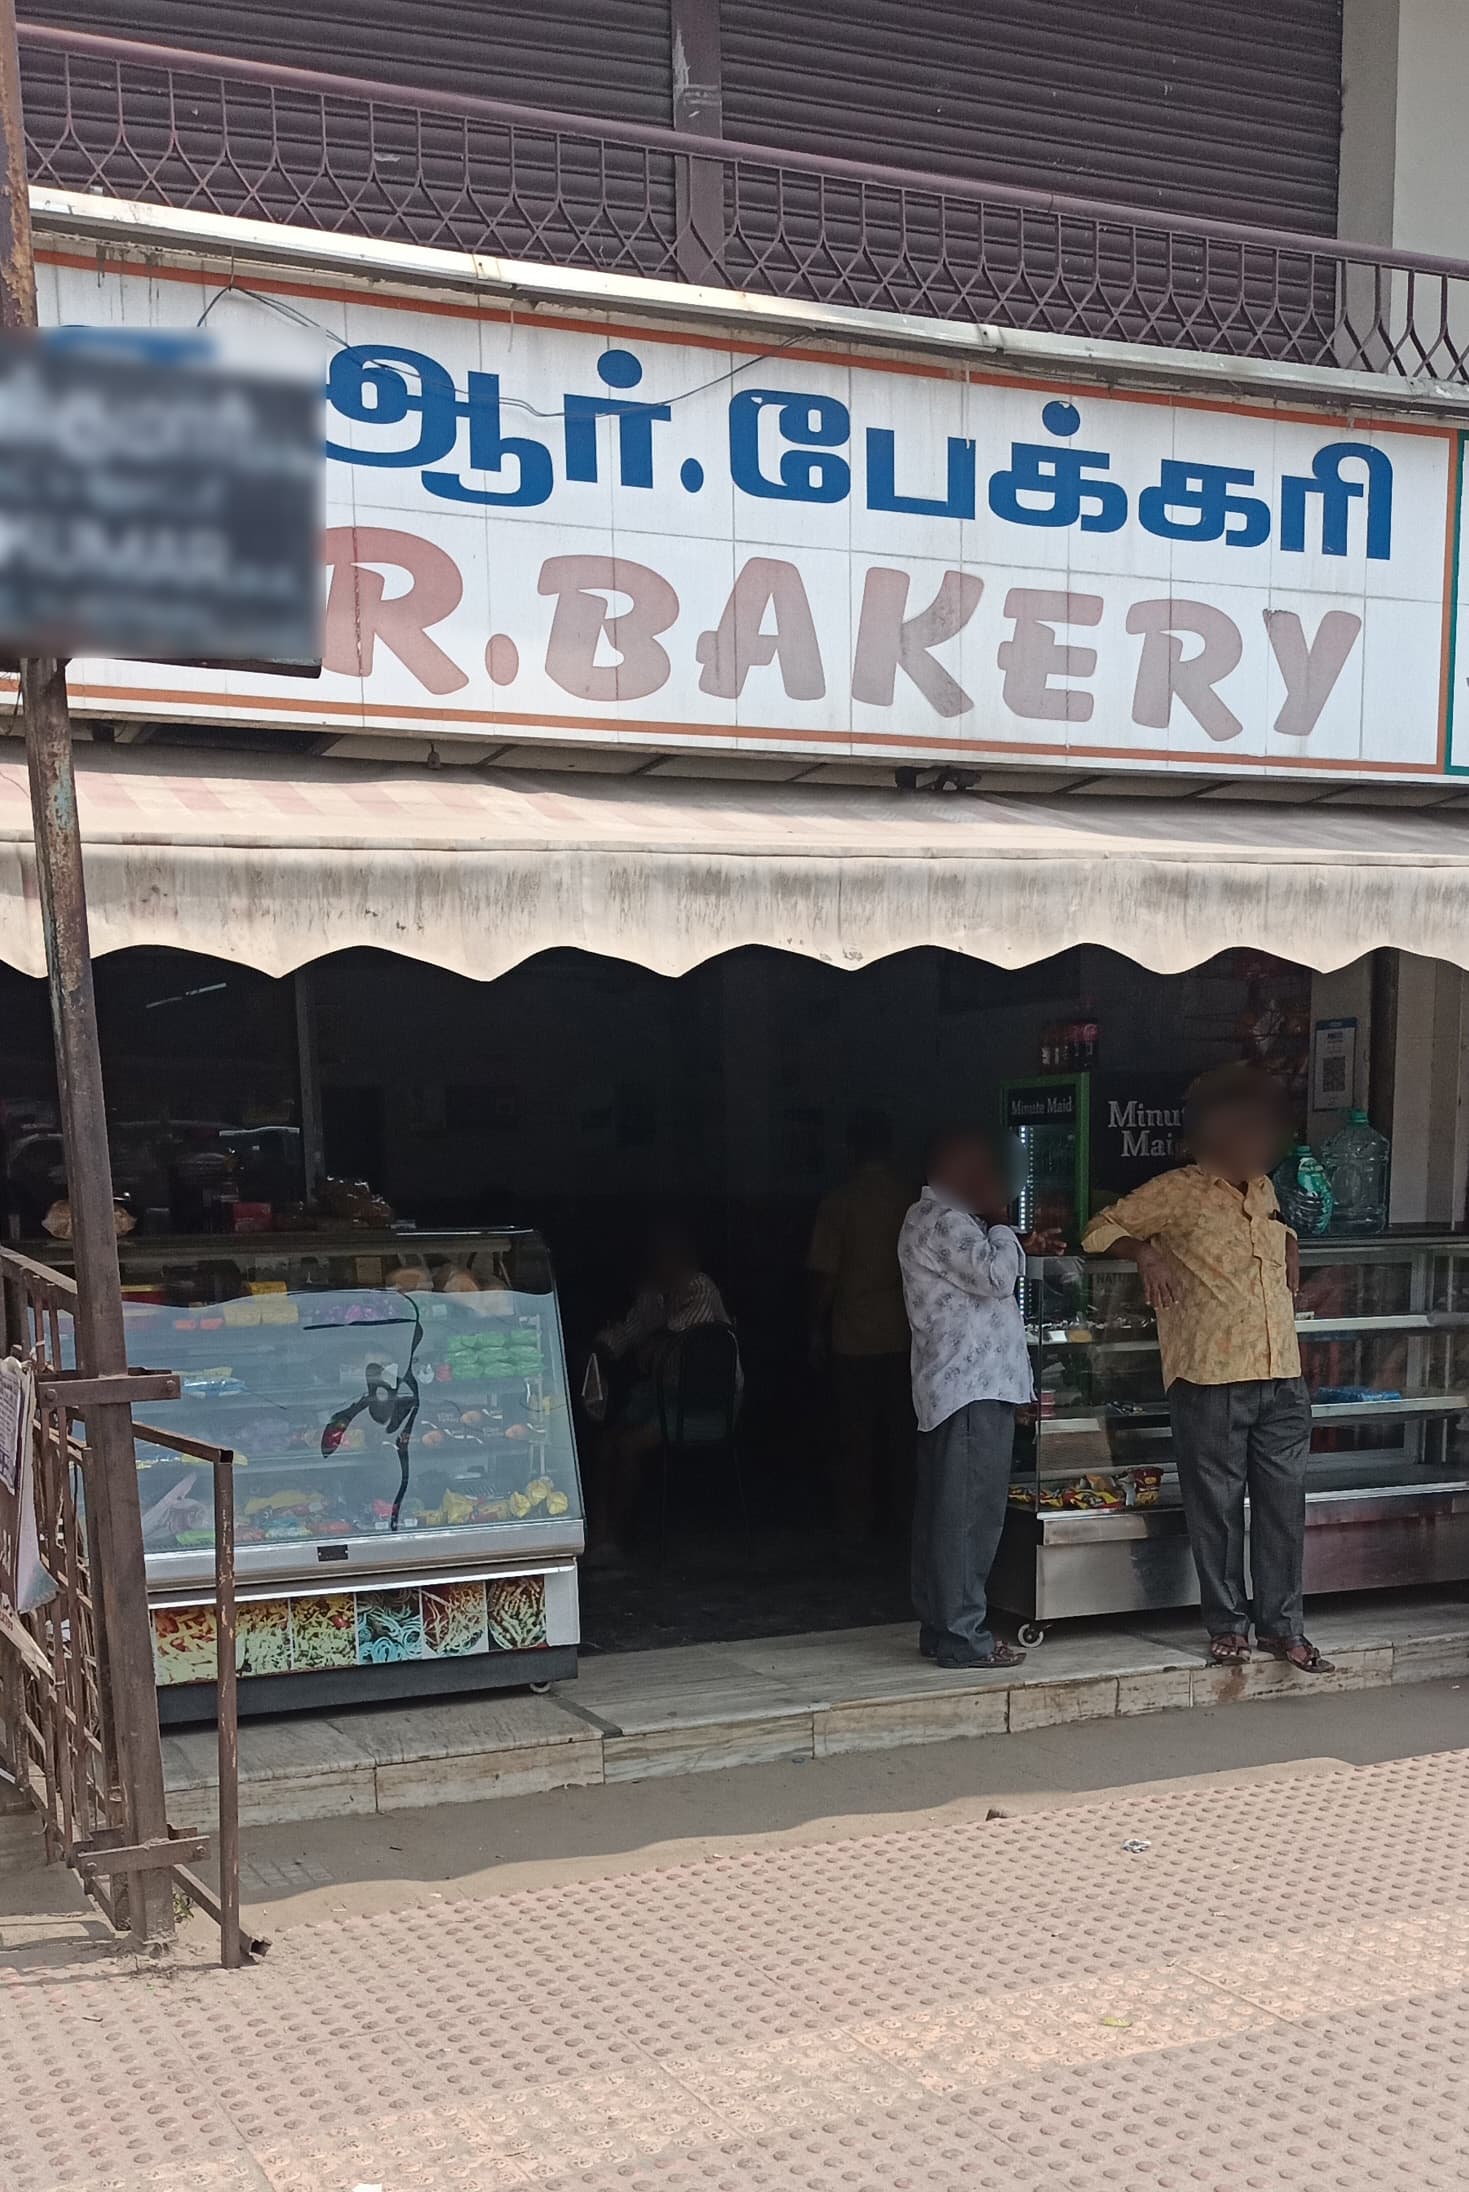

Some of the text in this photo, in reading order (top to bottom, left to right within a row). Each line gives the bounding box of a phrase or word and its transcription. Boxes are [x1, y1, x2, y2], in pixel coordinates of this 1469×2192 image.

[1011, 1096, 1073, 1115] Minute Maid
[1107, 1100, 1185, 1128] Minu
[1120, 1129, 1182, 1157] Mai
